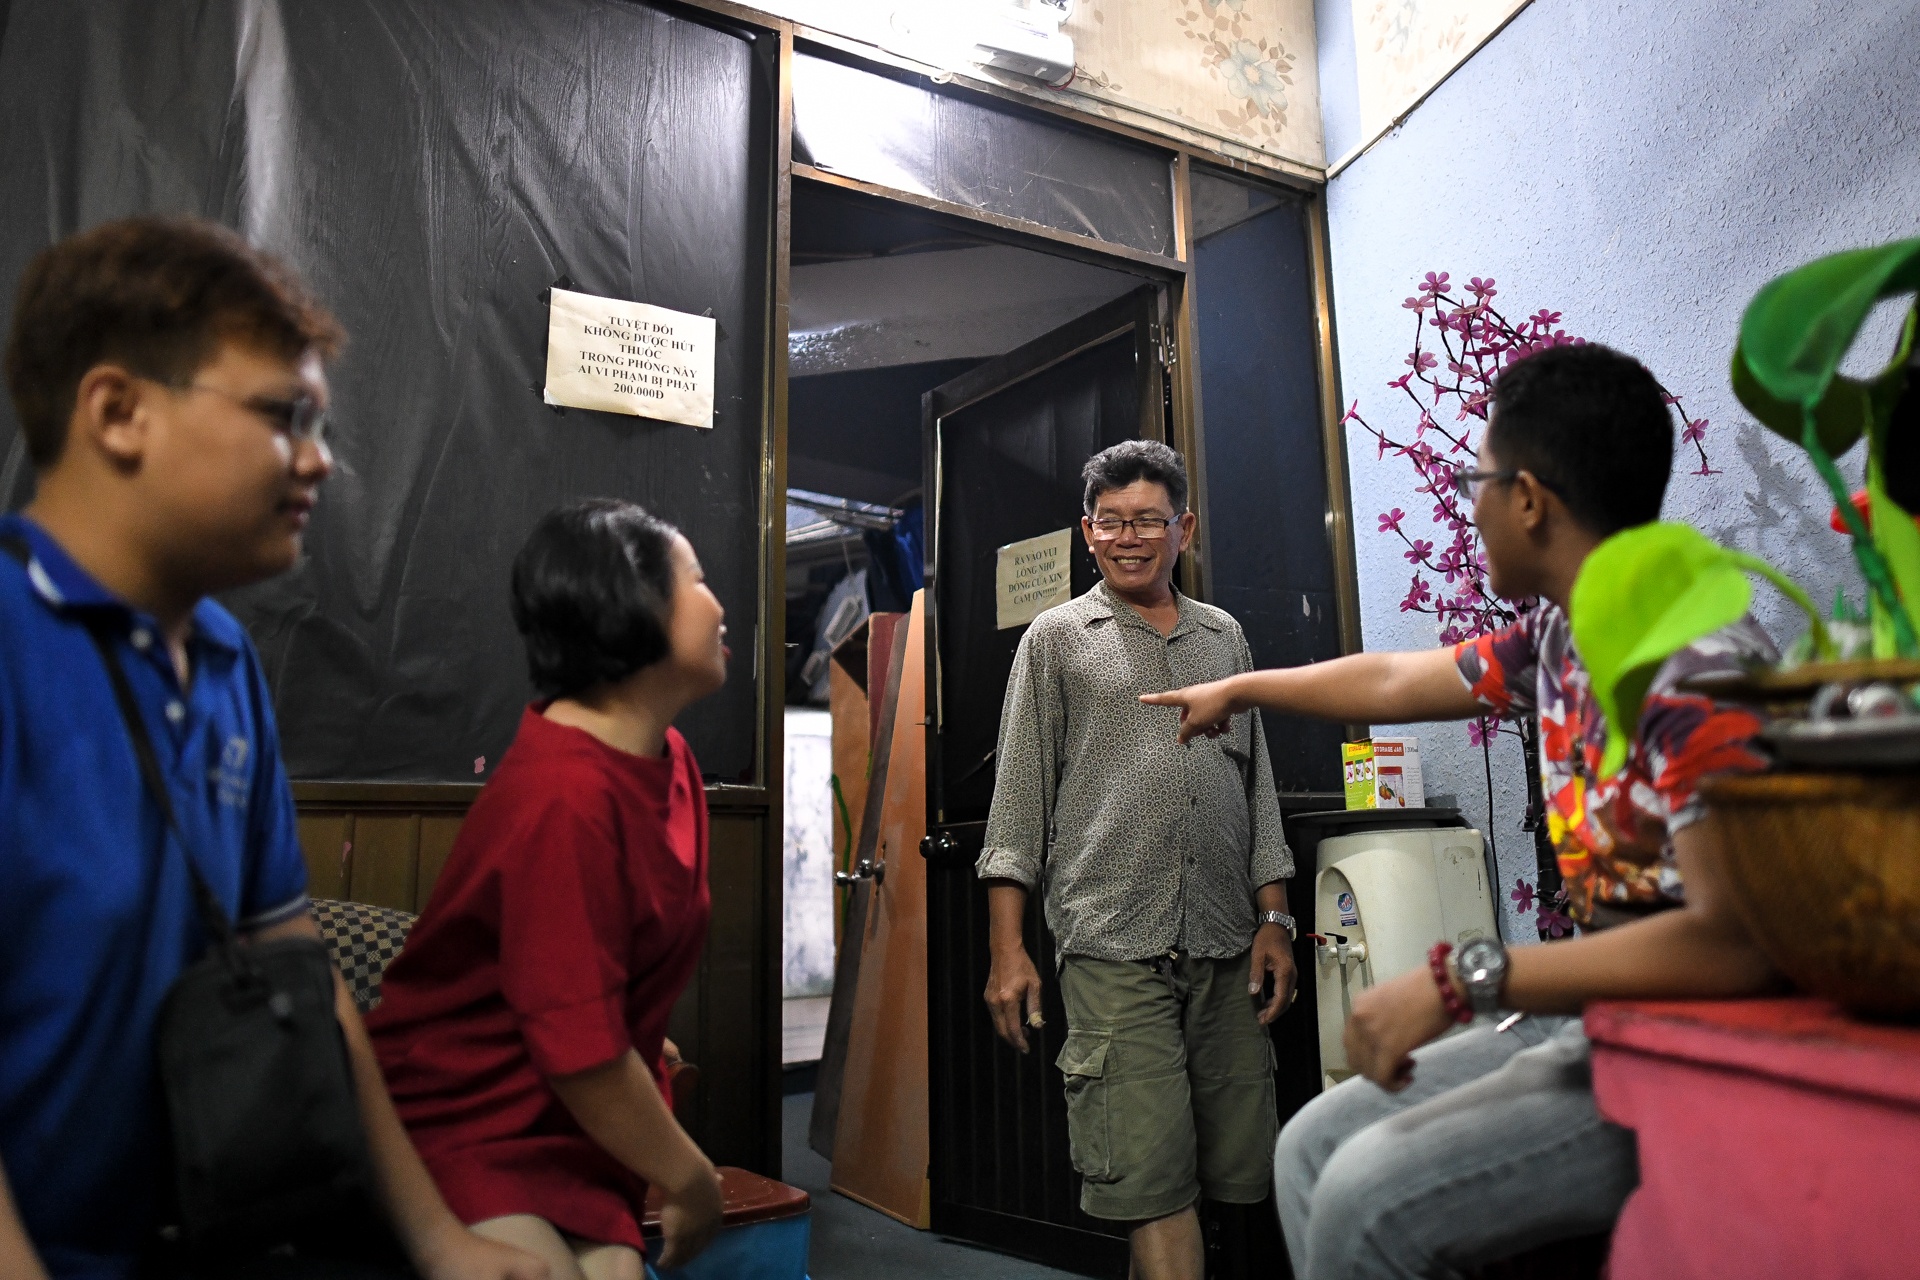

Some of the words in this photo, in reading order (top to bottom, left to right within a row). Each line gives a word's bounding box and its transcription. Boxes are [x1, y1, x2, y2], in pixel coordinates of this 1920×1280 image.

[584, 325, 630, 340] KHÔNG
[671, 340, 695, 352] HÚT
[580, 351, 624, 366] TRONG
[673, 365, 697, 378] NÀY
[578, 365, 591, 374] AI
[596, 367, 608, 376] VI
[612, 369, 648, 382] PHẠM
[651, 376, 662, 387] BỊ
[666, 378, 698, 392] PHẠT
[613, 383, 664, 399] 200.000Đ
[1014, 556, 1024, 565] RA
[1026, 550, 1042, 561] VÀO
[1043, 547, 1057, 557] VUI
[1049, 572, 1062, 583] XIN
